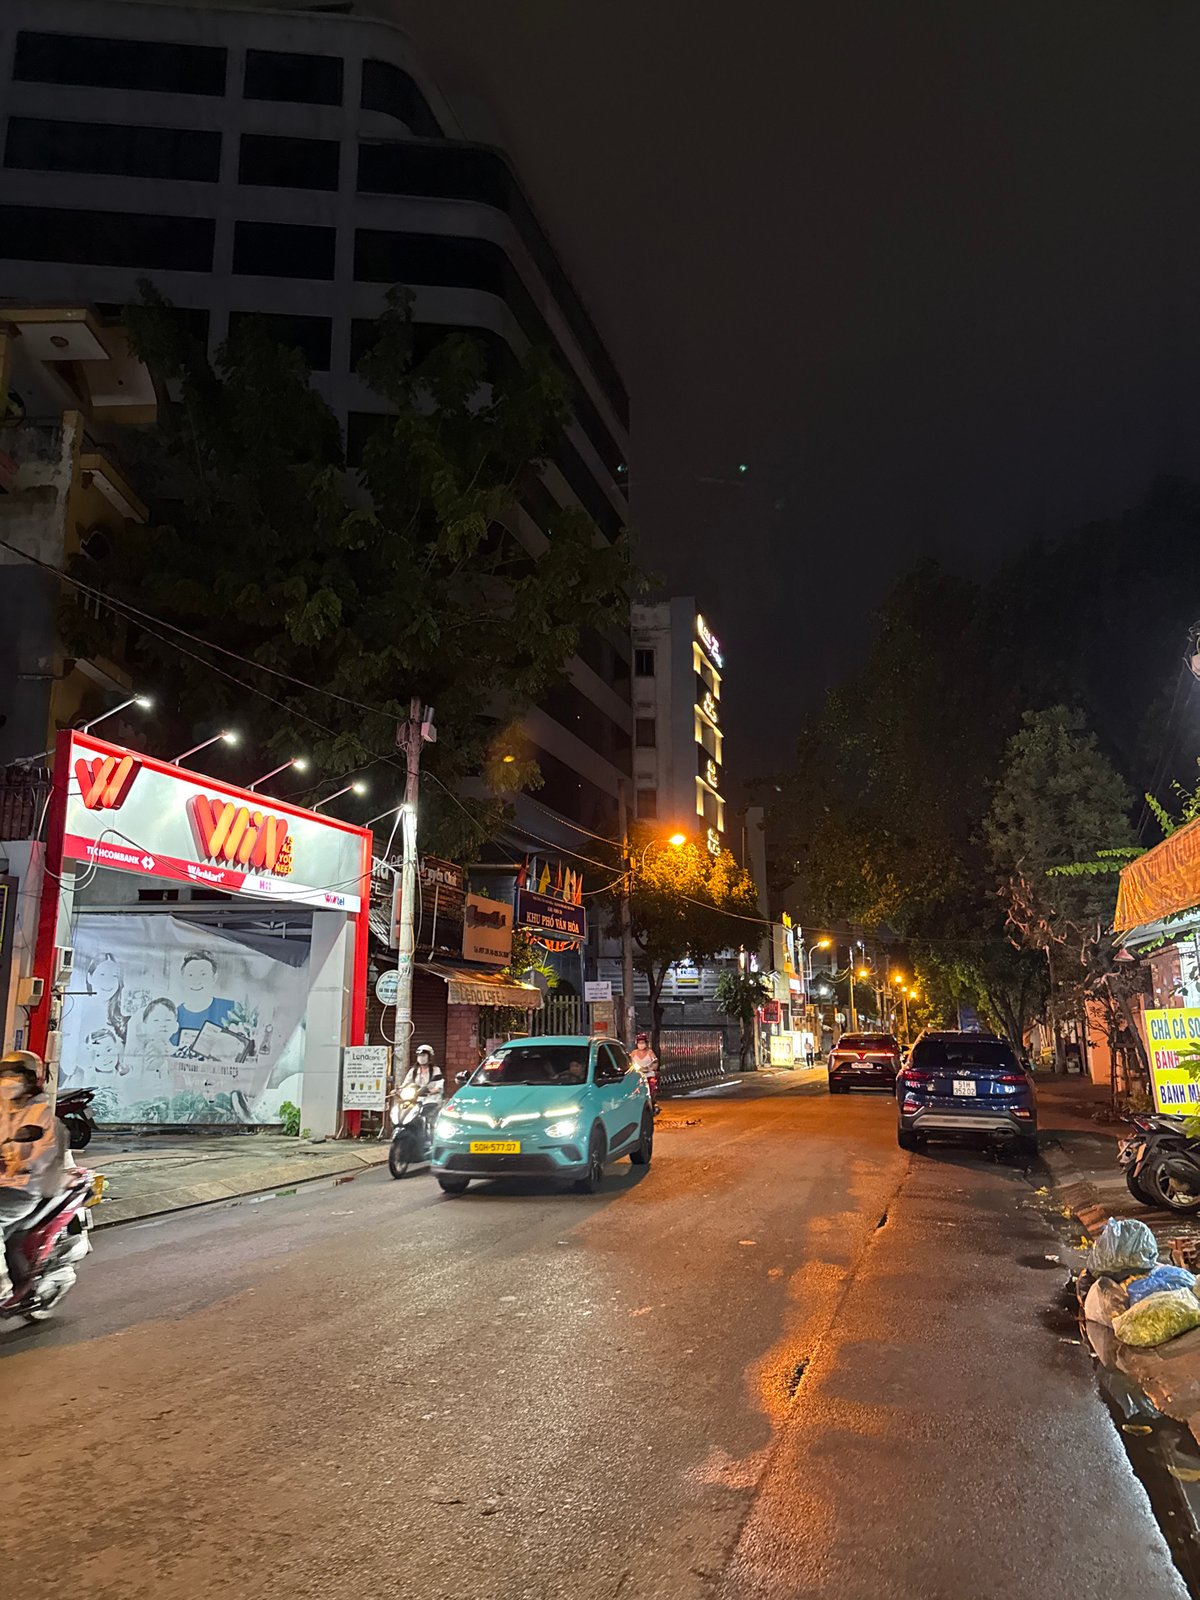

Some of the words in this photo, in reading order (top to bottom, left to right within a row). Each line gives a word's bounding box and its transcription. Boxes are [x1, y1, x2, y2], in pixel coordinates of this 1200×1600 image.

[86, 845, 140, 865] TECHCOMBANK
[279, 853, 294, 864] YOU
[275, 862, 294, 875] NEED
[526, 911, 541, 925] KHU
[1150, 1011, 1172, 1040] CHẢ
[1172, 1013, 1187, 1040] CÁ
[1159, 1081, 1187, 1104] BÁNH
